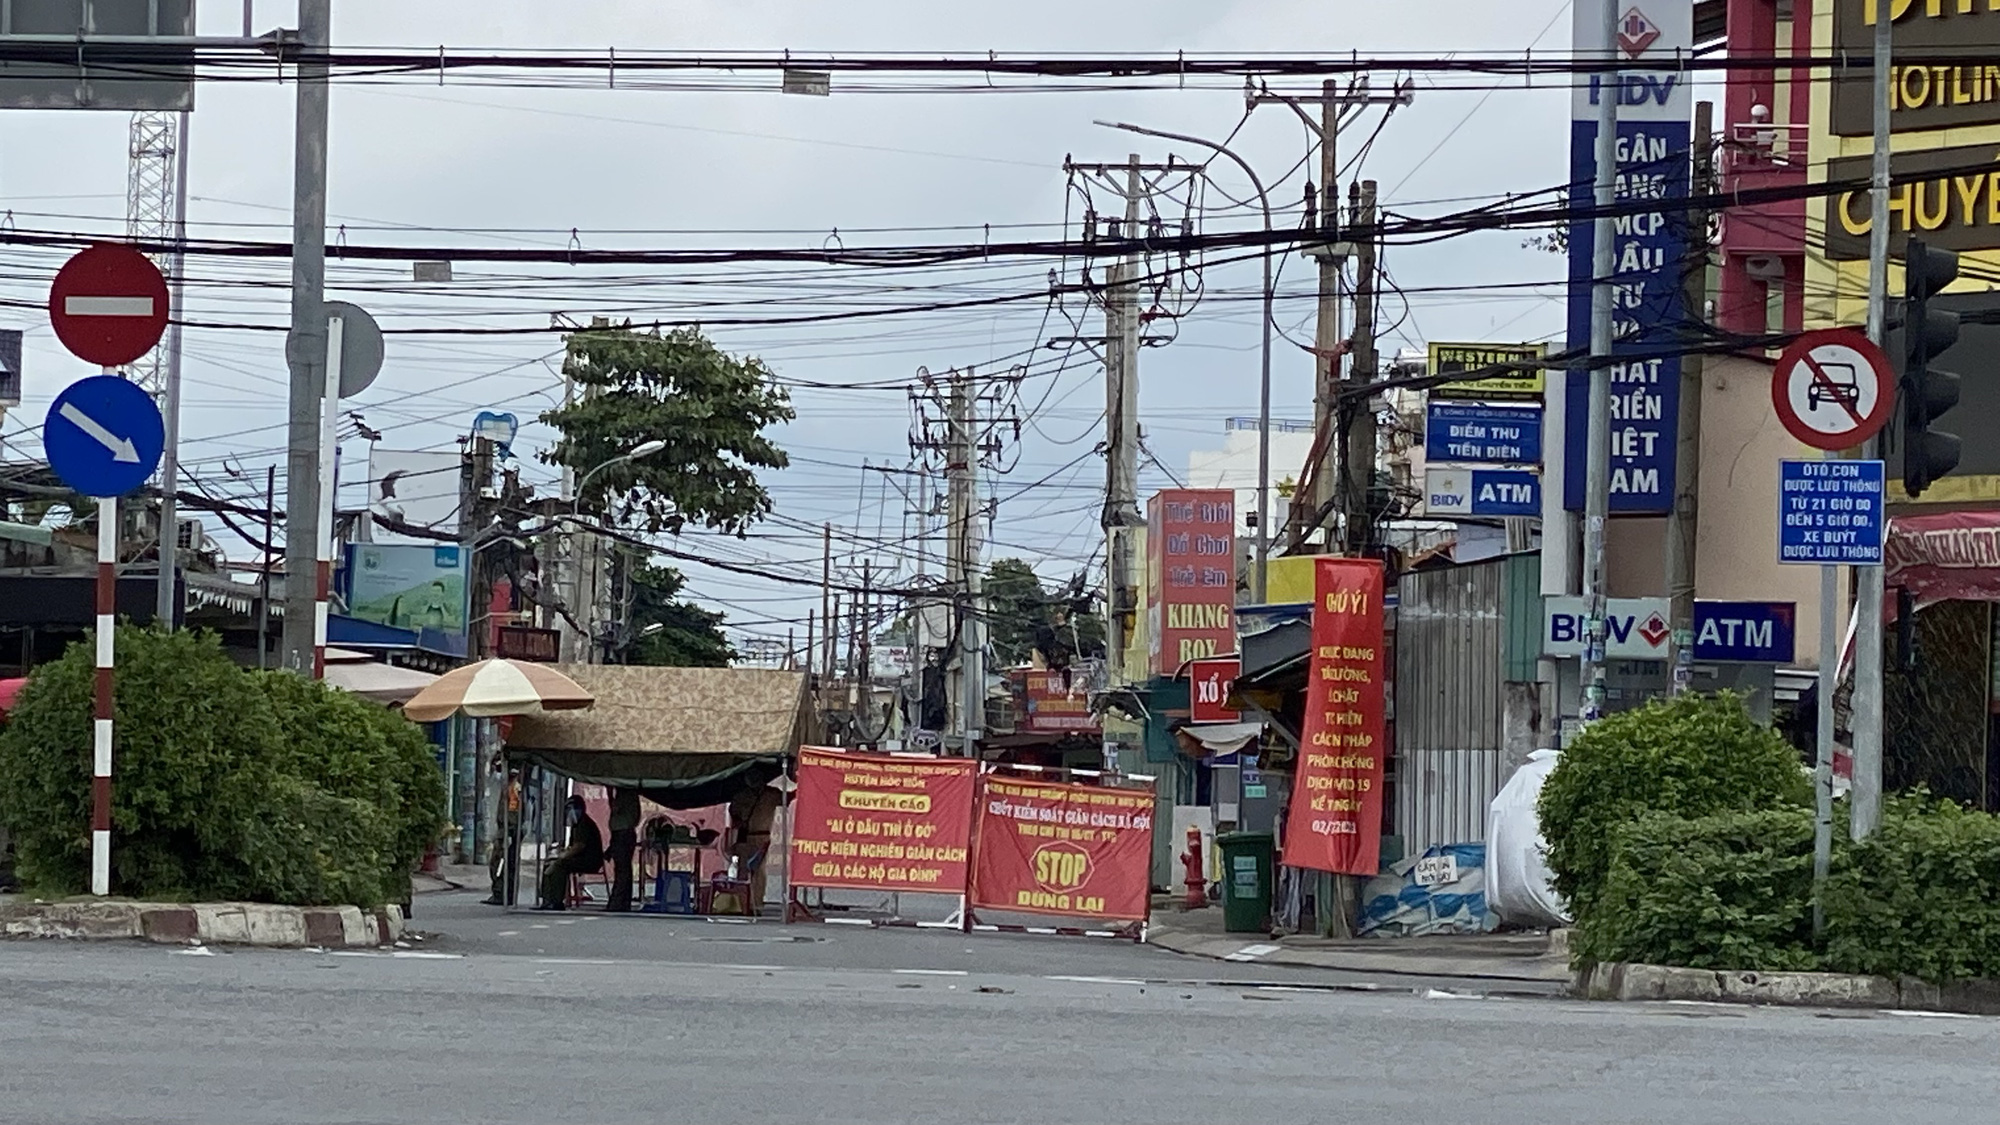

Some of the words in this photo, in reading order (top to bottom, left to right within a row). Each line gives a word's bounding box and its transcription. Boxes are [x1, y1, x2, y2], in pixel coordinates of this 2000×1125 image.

[1594, 133, 1666, 162] GÂN
[1614, 212, 1664, 236] MCP
[1610, 387, 1661, 419] RIỂN
[1491, 427, 1521, 440] THU
[1612, 427, 1659, 463] IỆT
[1610, 469, 1659, 493] AM
[1832, 465, 1860, 477] CON
[1431, 494, 1465, 507] BIDV
[1479, 483, 1532, 504] ATM
[1812, 498, 1825, 510] 21
[1856, 499, 1871, 511] 00
[1816, 514, 1824, 526] 5
[1803, 530, 1819, 543] XE
[1971, 526, 2000, 568] TR
[1167, 603, 1230, 630] KHANG
[1551, 613, 1636, 645] BIV
[1697, 618, 1773, 648] ATM
[1179, 639, 1218, 663] BOY
[844, 794, 896, 809] KHUYẾN
[899, 799, 926, 811] CÁO
[936, 847, 968, 863] CÁCH
[887, 867, 908, 881] GIA
[1036, 849, 1087, 887] STOP
